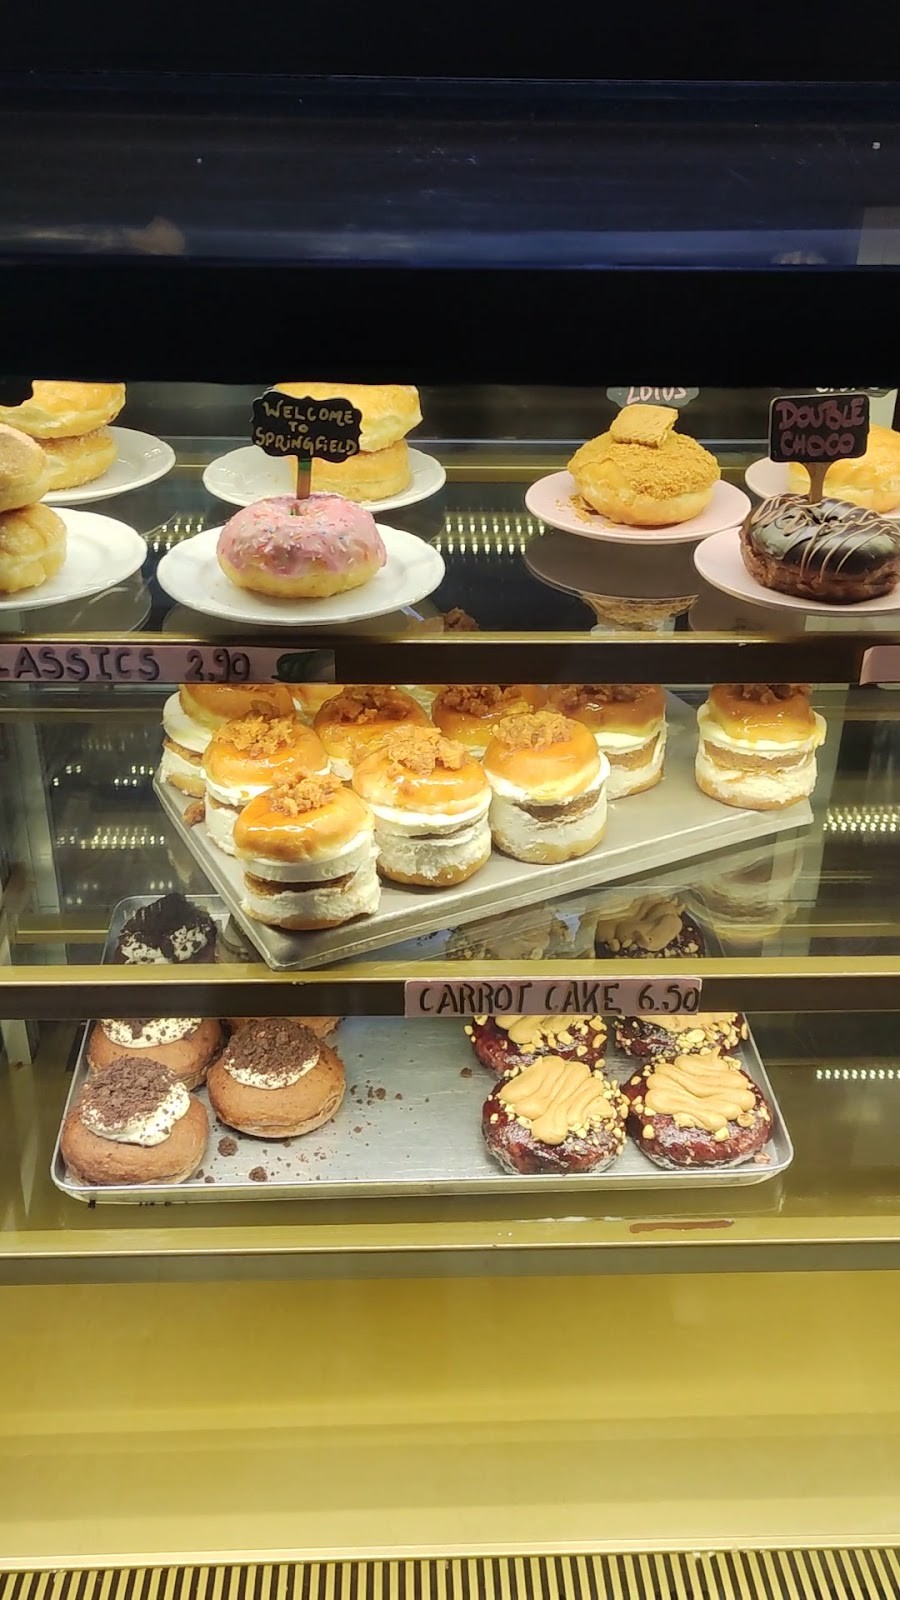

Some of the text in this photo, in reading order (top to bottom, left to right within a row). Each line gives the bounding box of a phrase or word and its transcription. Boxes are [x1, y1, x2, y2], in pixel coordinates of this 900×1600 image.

[262, 400, 354, 427] WELCOME
[288, 421, 309, 433] TO
[775, 397, 865, 431] DOUBLE
[780, 430, 855, 457] CHOCO
[184, 648, 250, 681] 2.90
[419, 981, 700, 1014] CARROT CAKE 6.50
